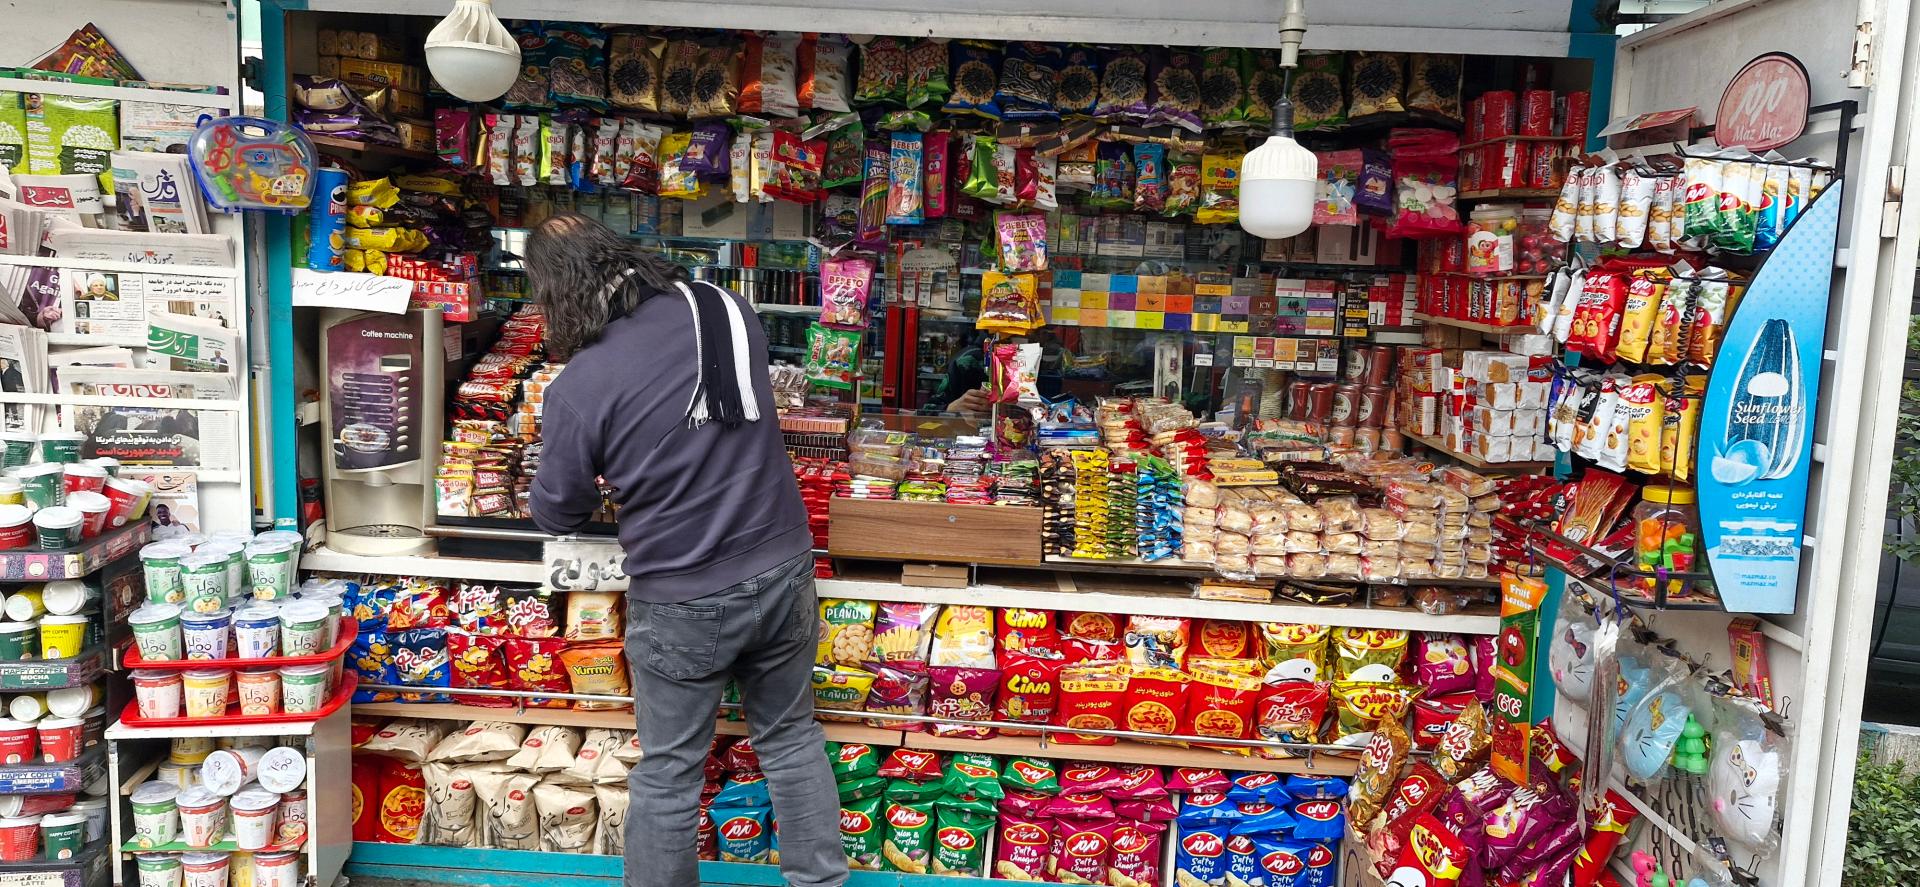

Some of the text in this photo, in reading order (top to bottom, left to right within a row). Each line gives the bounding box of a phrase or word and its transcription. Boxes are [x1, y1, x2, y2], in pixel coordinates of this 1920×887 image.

[1733, 121, 1784, 141] Maz Maz
[141, 168, 176, 200] قدس
[1005, 220, 1038, 230] BEBETO
[828, 275, 864, 288] BEBETO
[361, 329, 414, 340] Coffee machine
[1734, 400, 1805, 415] Sunflower
[1733, 412, 1766, 424] Seed
[1731, 491, 1783, 500] تخمه آفتابگردان
[1735, 502, 1777, 511] ترش لیمویی
[1741, 572, 1776, 580] mazmaz.co
[1740, 580, 1778, 588] mazmaz.net
[1509, 584, 1531, 598] Fruit
[1504, 597, 1533, 610] Leather
[572, 663, 614, 677] Yummy
[1159, 688, 1174, 697] حاوی
[1098, 700, 1112, 708] حاوی
[1228, 697, 1244, 705] حاوی
[1, 772, 30, 780] HAPPY
[726, 820, 753, 840] مزمز
[942, 830, 969, 847] مزمز
[1072, 835, 1099, 853] مزمز
[1188, 834, 1215, 854] مزمز
[1013, 845, 1031, 856] Salt
[1074, 858, 1092, 867] Salt
[1116, 853, 1134, 863] Salt
[1190, 857, 1215, 868] Salty
[1231, 855, 1254, 866] Salty
[1269, 854, 1296, 874] مزمز
[1190, 866, 1214, 876] Chips
[1231, 864, 1254, 876] Chips
[21, 879, 46, 887] LATTE
